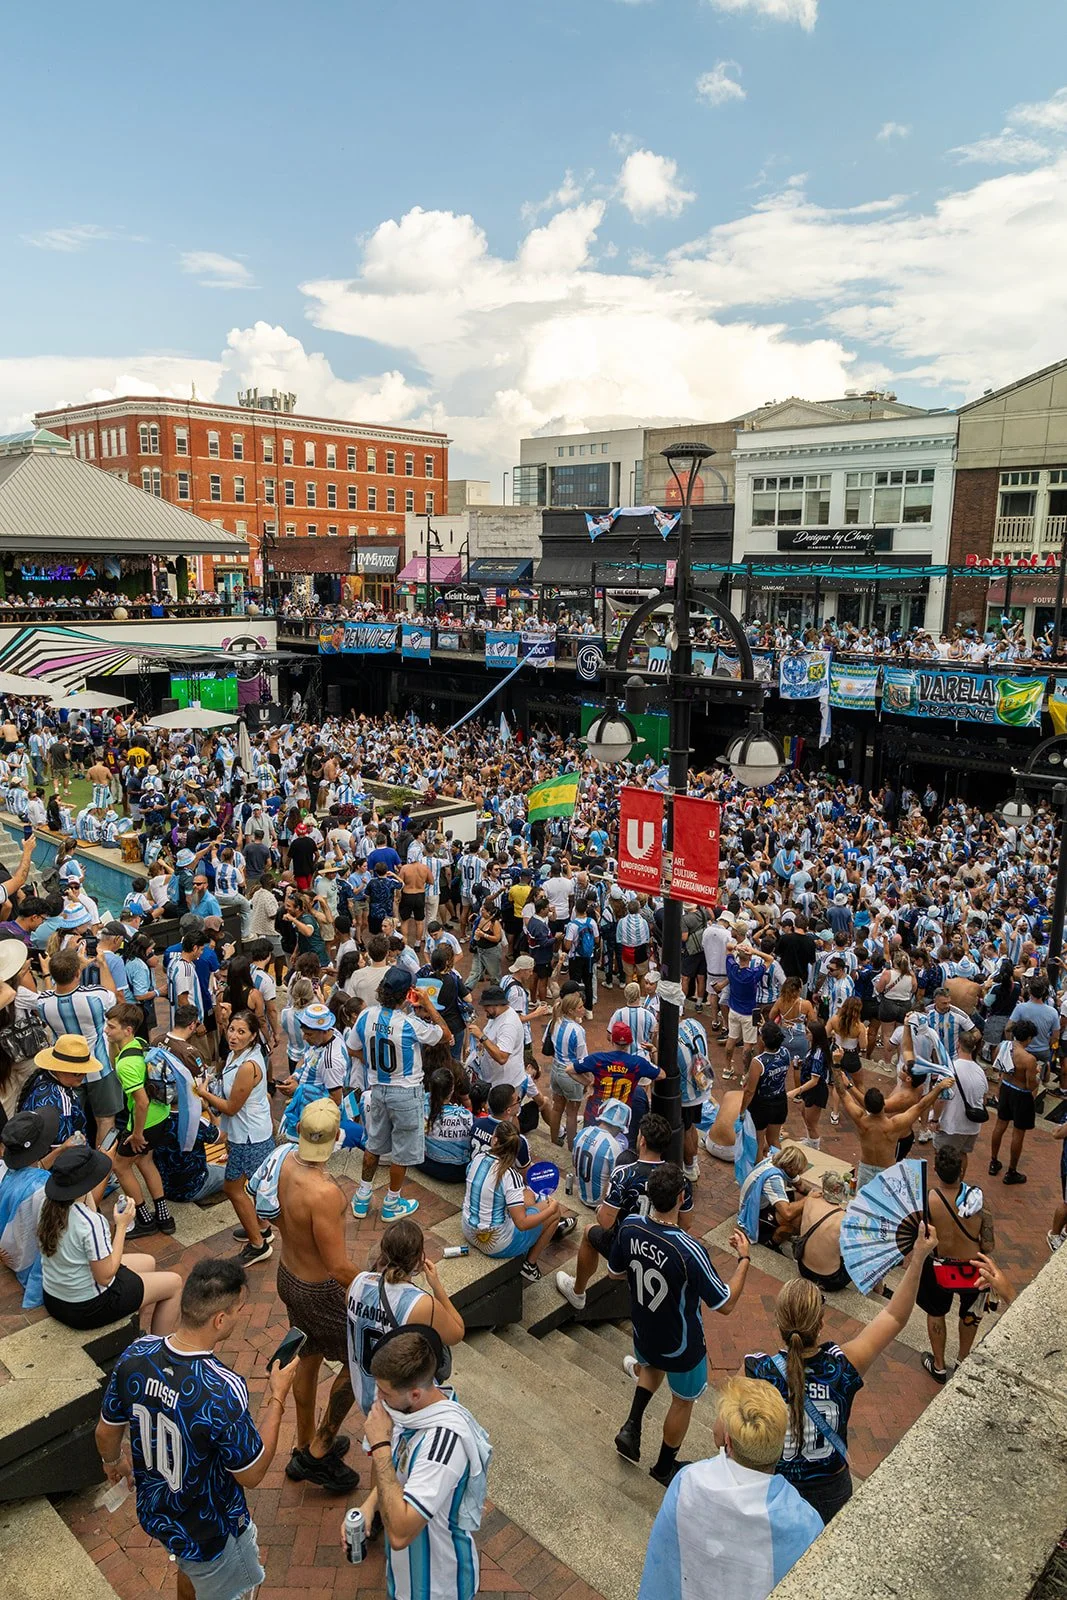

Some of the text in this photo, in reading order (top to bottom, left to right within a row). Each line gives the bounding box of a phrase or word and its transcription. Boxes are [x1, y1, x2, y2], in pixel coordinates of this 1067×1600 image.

[793, 530, 875, 545] Designs by Chris
[21, 564, 96, 578] UTOPA
[444, 590, 480, 602] Kickit Kourt
[918, 673, 998, 708] VARELA
[259, 709, 270, 721] U
[918, 702, 995, 723] PRESENTE
[626, 818, 655, 861] U
[708, 829, 716, 839] U
[673, 856, 686, 868] ART.
[847, 851, 858, 862] 10
[462, 864, 475, 880] 10
[620, 860, 659, 876] UNDERGROUND
[671, 877, 716, 897] ENTERTAINMENT.
[372, 1022, 394, 1036] MESSI
[369, 1035, 398, 1074] 10
[607, 1065, 629, 1074] MESSI
[600, 1076, 633, 1103] 10
[440, 1117, 472, 1127] HORA DE
[438, 1128, 471, 1139] ALENTAR
[573, 1146, 593, 1184] 10
[630, 1237, 669, 1270] MESSI
[629, 1259, 669, 1313] 19
[132, 1402, 183, 1494] 10
